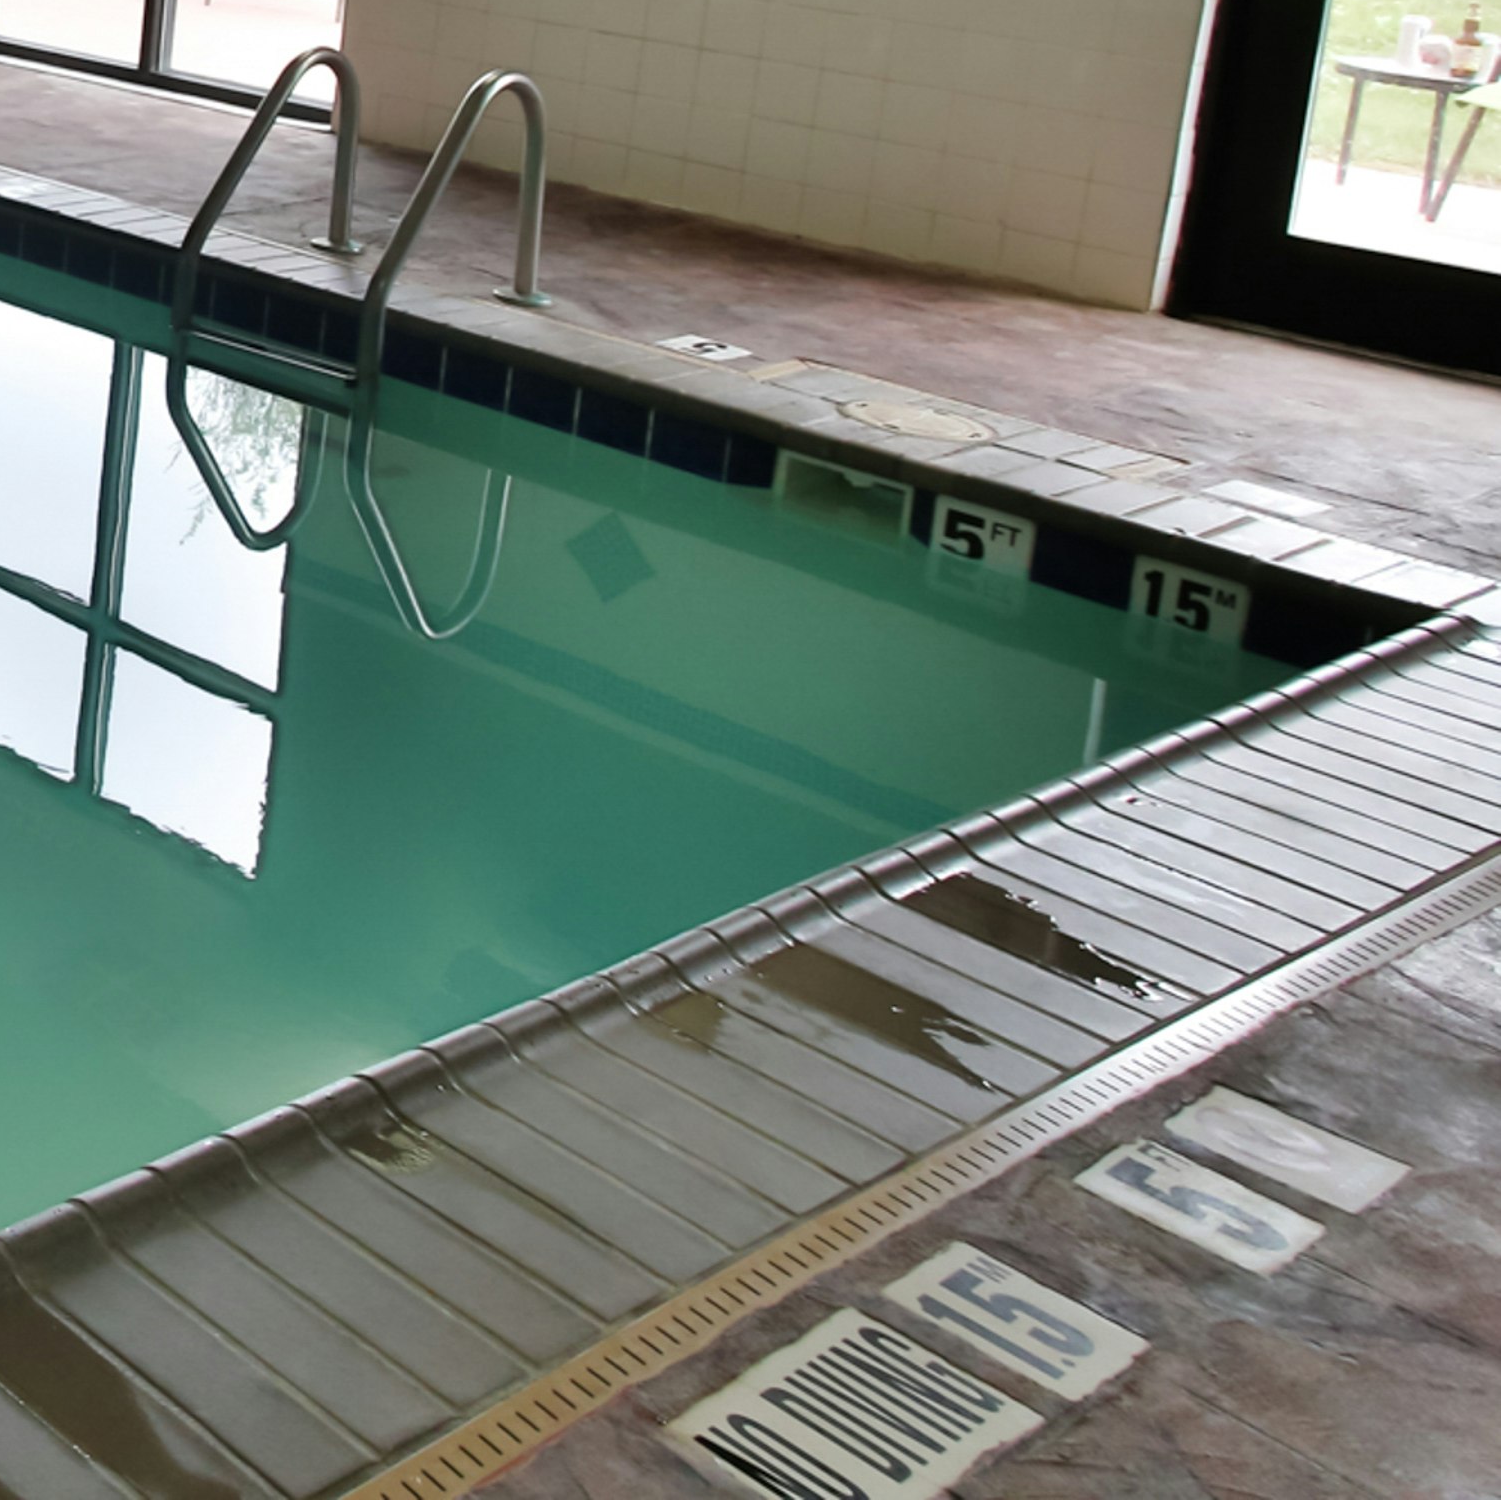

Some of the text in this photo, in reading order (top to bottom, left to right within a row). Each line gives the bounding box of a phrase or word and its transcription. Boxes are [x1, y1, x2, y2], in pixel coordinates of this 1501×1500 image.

[939, 508, 1023, 561] 5 FT
[1216, 589, 1237, 610] M
[1105, 1156, 1290, 1251] 5
[916, 1267, 1097, 1380] 1.5
[693, 1326, 1005, 1500] NO DIVING
